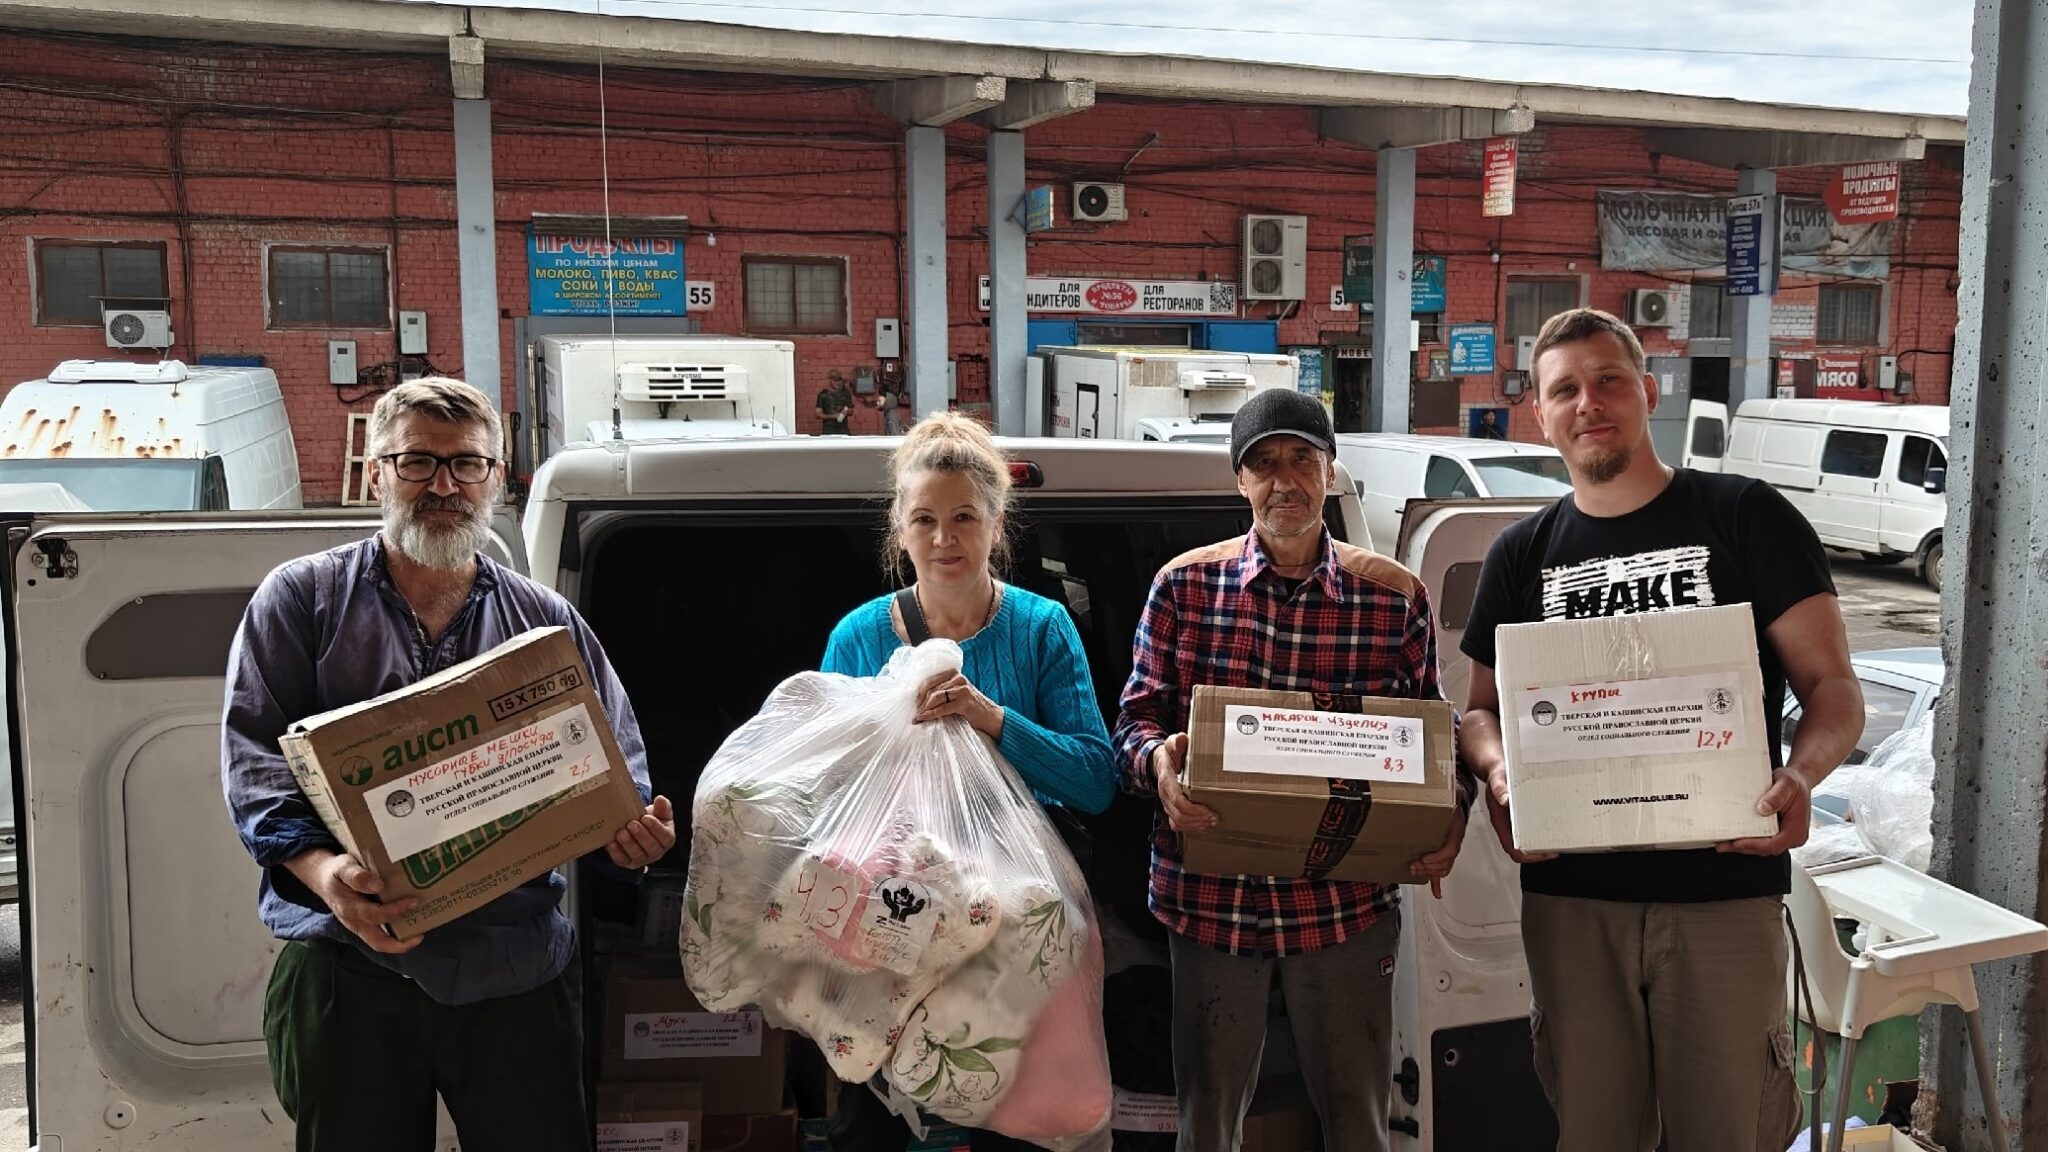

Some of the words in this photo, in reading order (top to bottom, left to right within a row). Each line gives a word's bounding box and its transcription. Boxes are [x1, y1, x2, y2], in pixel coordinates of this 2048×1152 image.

[1843, 161, 1898, 179] МОЛОЧНЫЕ
[1843, 176, 1896, 196] ПРОДУКТЫ
[1602, 202, 1713, 223] МОЛОЧНАЯ
[555, 259, 571, 267] ПО
[575, 259, 619, 268] НИЗКИМ
[623, 260, 658, 268] ЦЕНАМ
[535, 268, 596, 280] МОЛОКО,
[645, 269, 679, 280] КВАС
[562, 281, 598, 291] СОКИ
[604, 281, 613, 291] И
[618, 281, 655, 292] ВОДЫ
[1058, 282, 1080, 294] ДЛЯ
[1091, 282, 1133, 295] ПРОДУКТЫ
[1143, 284, 1165, 295] ДЛЯ
[689, 287, 712, 305] 55
[1143, 298, 1205, 311] РЕСТОРАНОВ
[1334, 290, 1348, 306] 5
[1565, 569, 1699, 619] MAKE
[496, 695, 515, 714] 15
[528, 679, 557, 699] 750
[1561, 711, 1602, 721] ТВЕРСКАЯ
[1610, 706, 1664, 717] КАШИНСКАЯ
[1665, 703, 1704, 714] ЕПАРХИЯ
[1263, 725, 1300, 734] ТВЕРСКАЯ
[1562, 722, 1601, 733] РУССКОЙ
[1602, 717, 1668, 730] ПРАВОСЛАВНОЙ
[1669, 716, 1702, 725] ЦЕРКВИ
[486, 726, 538, 754] МЕШКИ
[1697, 730, 1733, 749] 12,4
[419, 783, 463, 806] ТВЕРСКАЯ
[464, 778, 471, 786] И
[471, 757, 524, 783] КАШИНСКАЯ
[524, 740, 561, 761] ЕПАРХИЯ
[454, 759, 491, 781] ГУБКИ
[569, 753, 593, 779] 2,5
[1384, 757, 1404, 772] 8,3
[425, 793, 465, 817] РУССКОЙ
[466, 765, 532, 800] ПРАВОСЛАВНОЙ
[532, 753, 563, 775] ЦЕРКВИ
